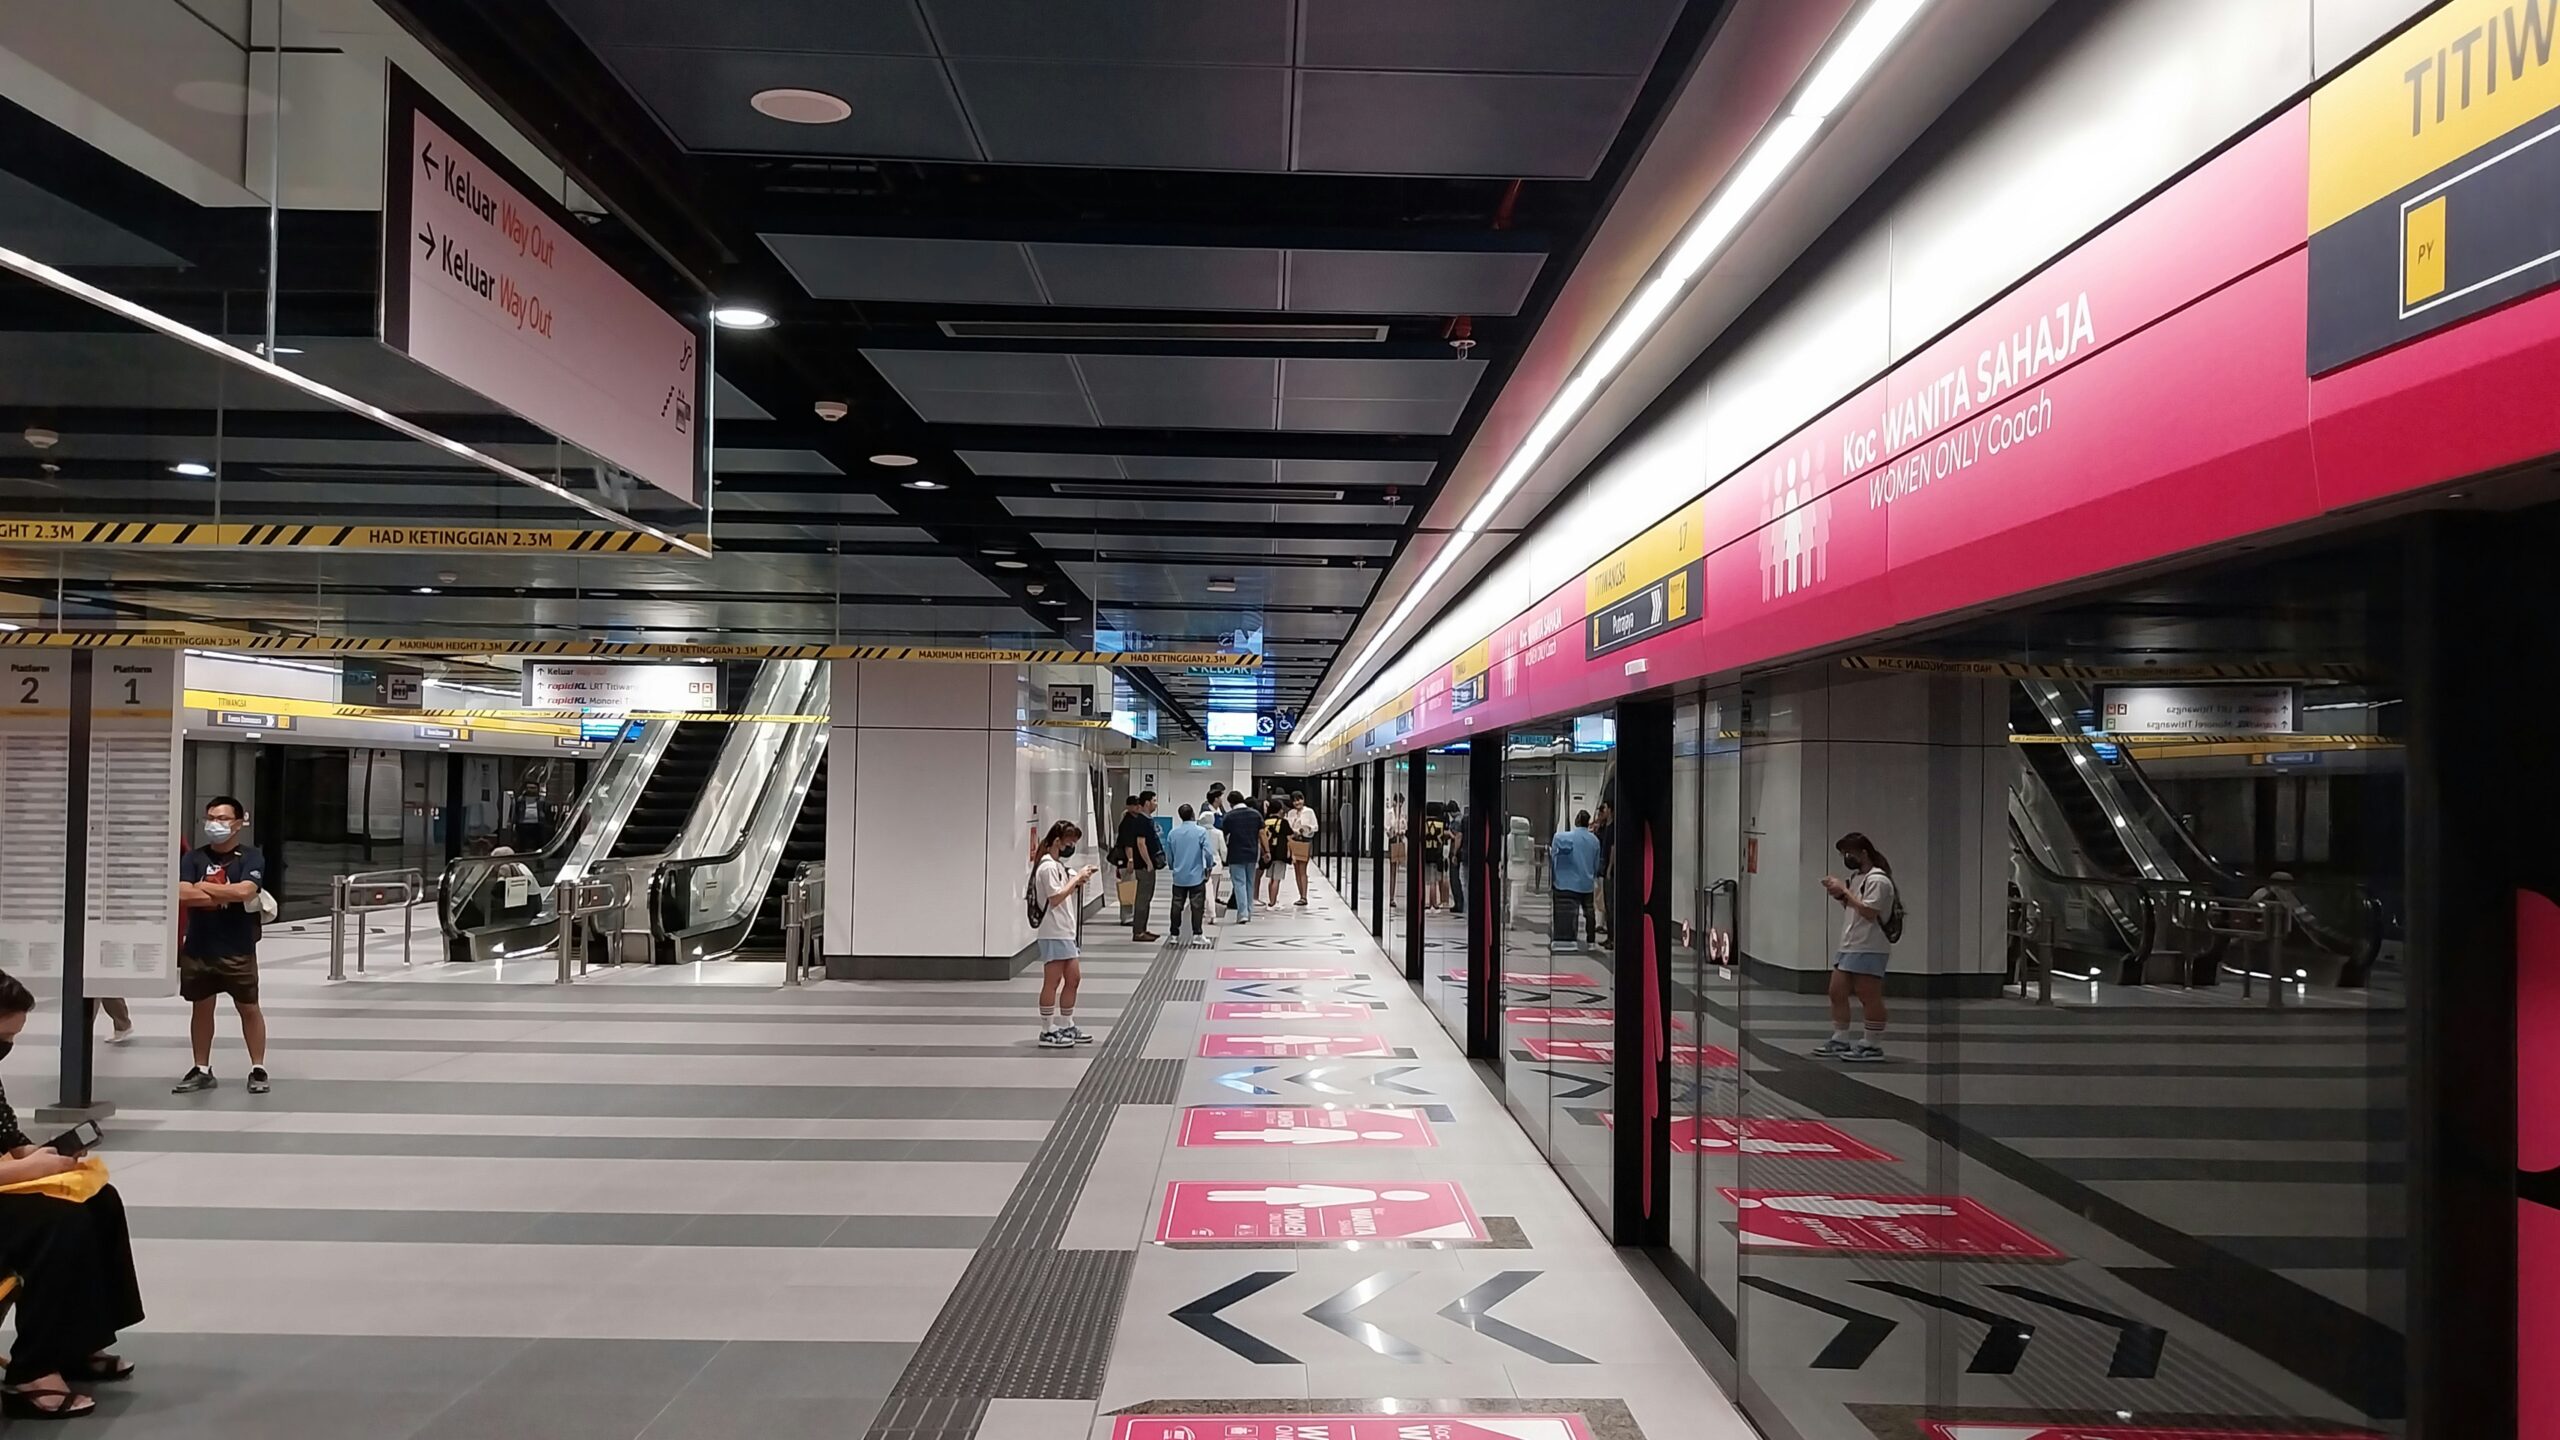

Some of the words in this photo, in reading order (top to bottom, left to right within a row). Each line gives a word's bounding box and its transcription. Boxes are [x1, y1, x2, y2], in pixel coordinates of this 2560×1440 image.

[444, 155, 497, 225] Keluar
[502, 200, 529, 257] Way
[531, 225, 554, 268] Out
[2417, 240, 2434, 264] PY
[442, 235, 495, 300] Keluar
[500, 274, 527, 330] Way
[530, 296, 552, 339] Out
[1842, 430, 1877, 477] Koc
[1881, 365, 1970, 455] WANITA
[1976, 292, 2095, 404] SAHAJA
[1869, 456, 1931, 510] WOMEN
[1935, 423, 1984, 481] ONLY
[1987, 389, 2052, 456] Coach
[35, 525, 74, 539] 2.3M
[369, 530, 404, 544] HAD
[409, 531, 508, 545] KETINGGIAN
[513, 532, 552, 546] 2.3M
[142, 636, 161, 645] HAD
[163, 637, 216, 646] KETINGGIAN
[218, 638, 240, 647] 2.3M
[399, 641, 444, 650] MAXIMUM
[446, 642, 478, 650] HEIGHT
[481, 643, 502, 651] 2.3M
[658, 645, 679, 654] HAD
[680, 646, 734, 655] KETINGGIAN
[736, 647, 758, 656] 2.3M
[918, 650, 962, 660] MAXIMUM
[965, 651, 997, 661] HEIGHT
[999, 651, 1020, 661] 2.3M
[1130, 655, 1150, 663] HAD
[1152, 655, 1204, 664] KETINGGIAN
[1206, 655, 1227, 664] 2.3M
[10, 664, 50, 673] Platform
[113, 665, 152, 674] Platform
[20, 677, 39, 704] 2
[124, 678, 140, 704] 1
